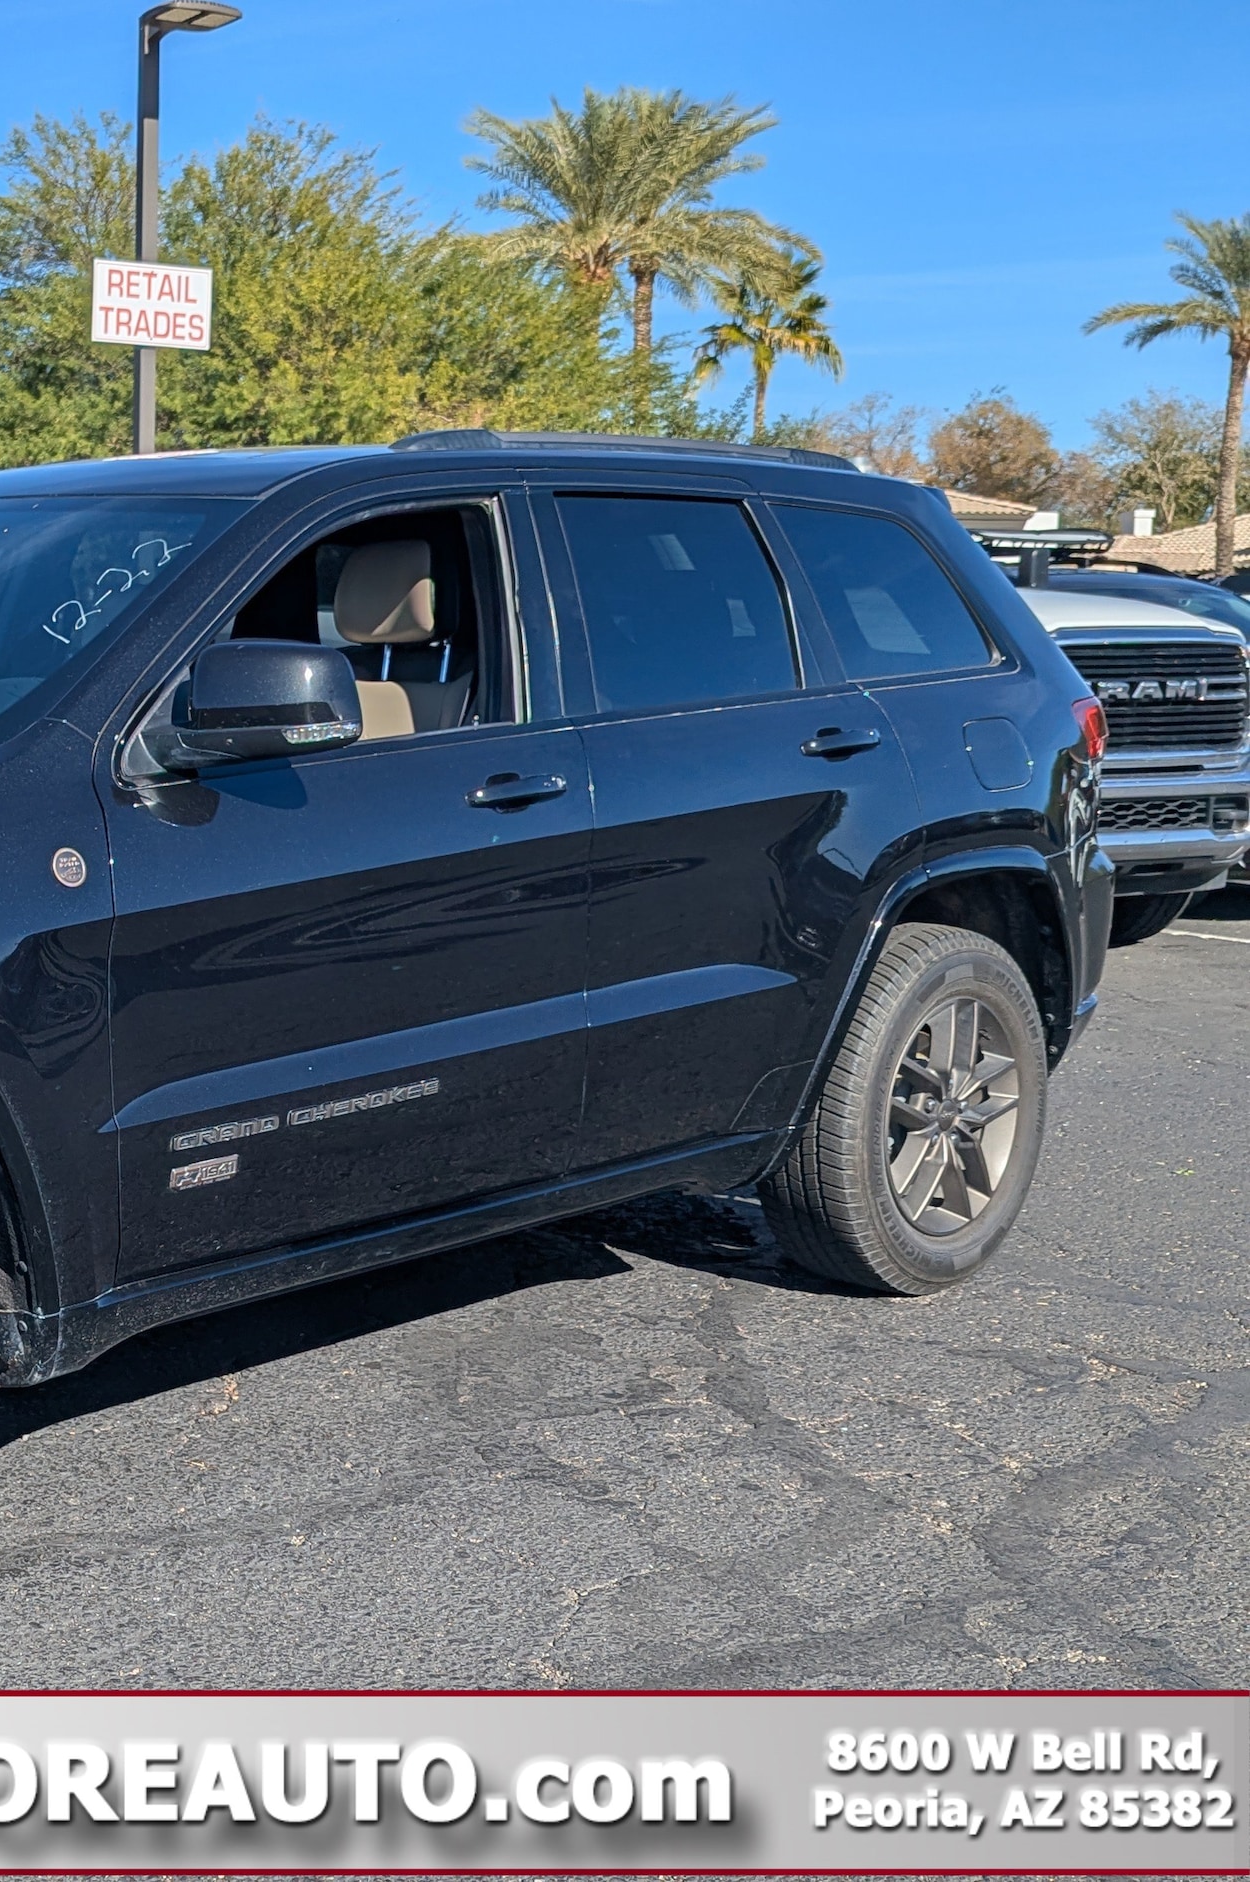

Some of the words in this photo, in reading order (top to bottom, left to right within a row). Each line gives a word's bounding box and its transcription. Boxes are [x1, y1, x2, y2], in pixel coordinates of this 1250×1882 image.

[107, 268, 198, 304] RETAIL
[99, 306, 204, 342] TRADES
[1096, 680, 1198, 700] RAM
[170, 1114, 280, 1152] GRAND
[287, 1077, 440, 1126] CHEROKEE
